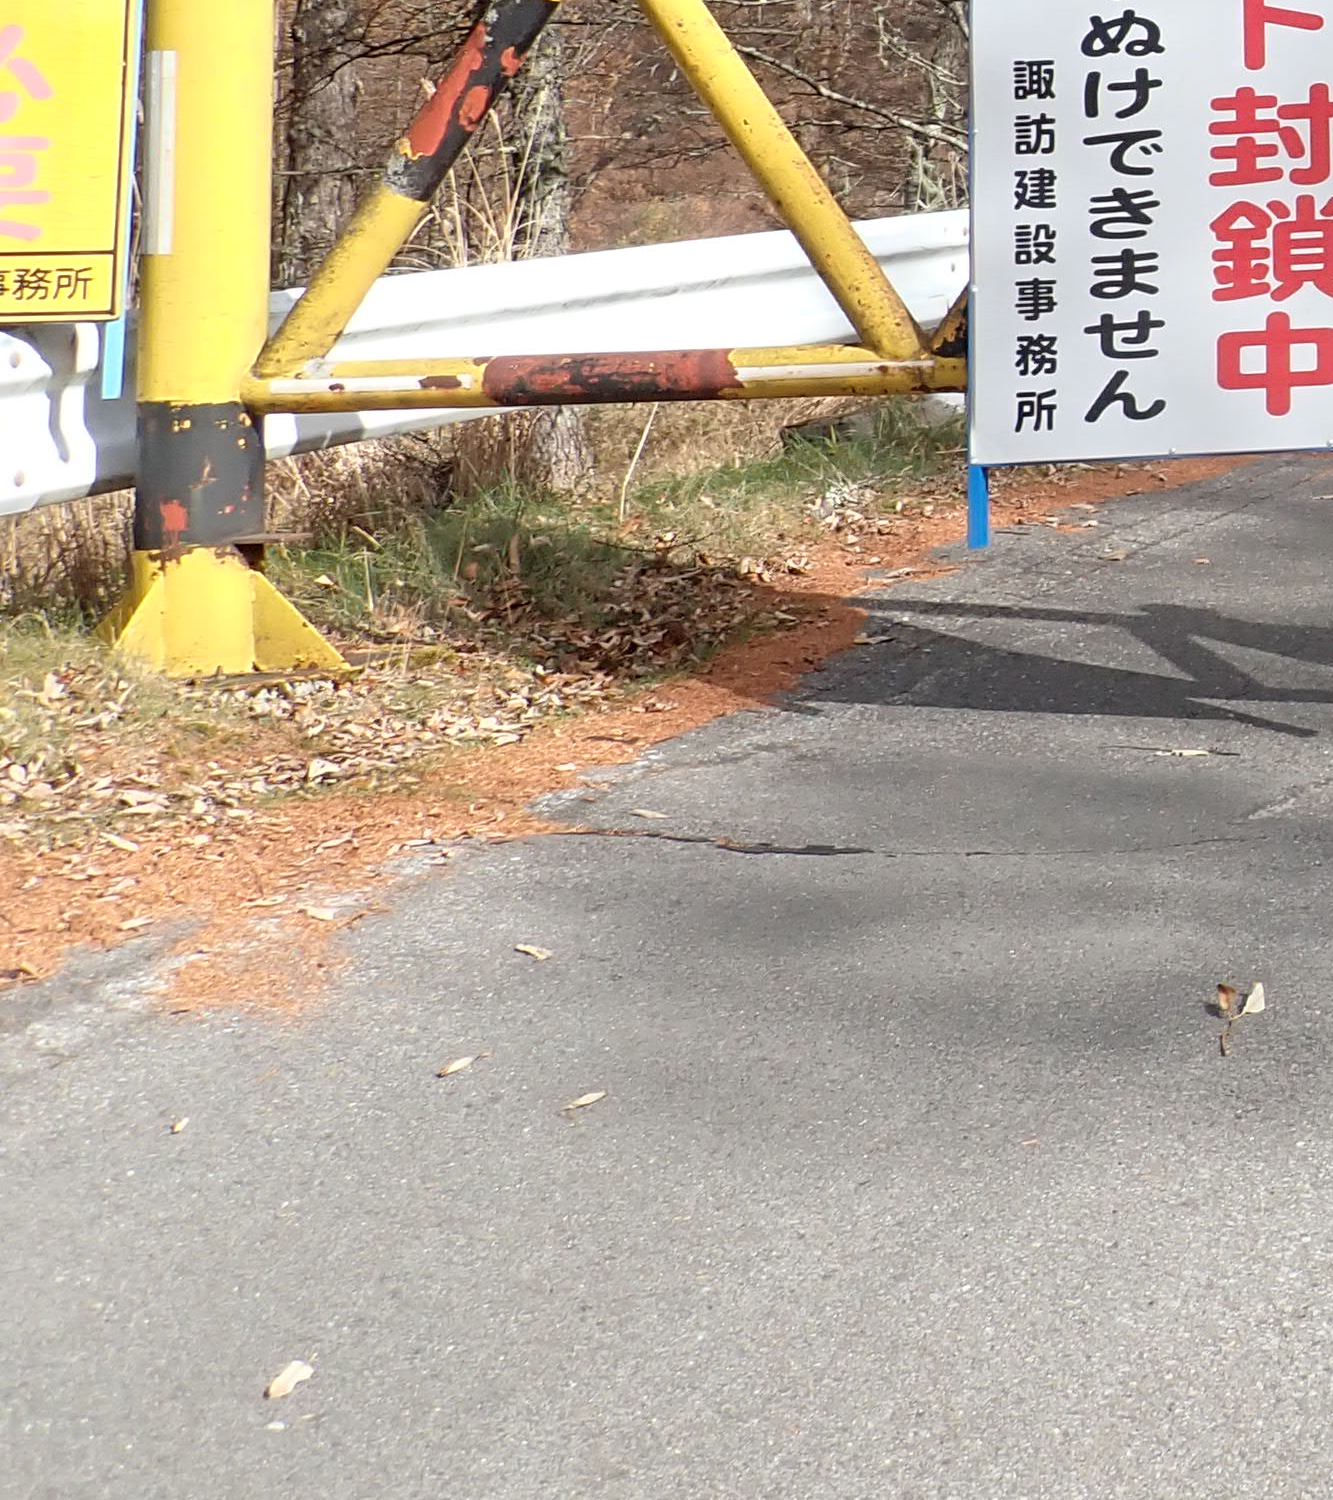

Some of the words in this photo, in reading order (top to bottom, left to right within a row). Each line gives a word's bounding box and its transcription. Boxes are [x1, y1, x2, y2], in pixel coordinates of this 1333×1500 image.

[1013, 60, 1058, 433] 諏訪建設事務所
